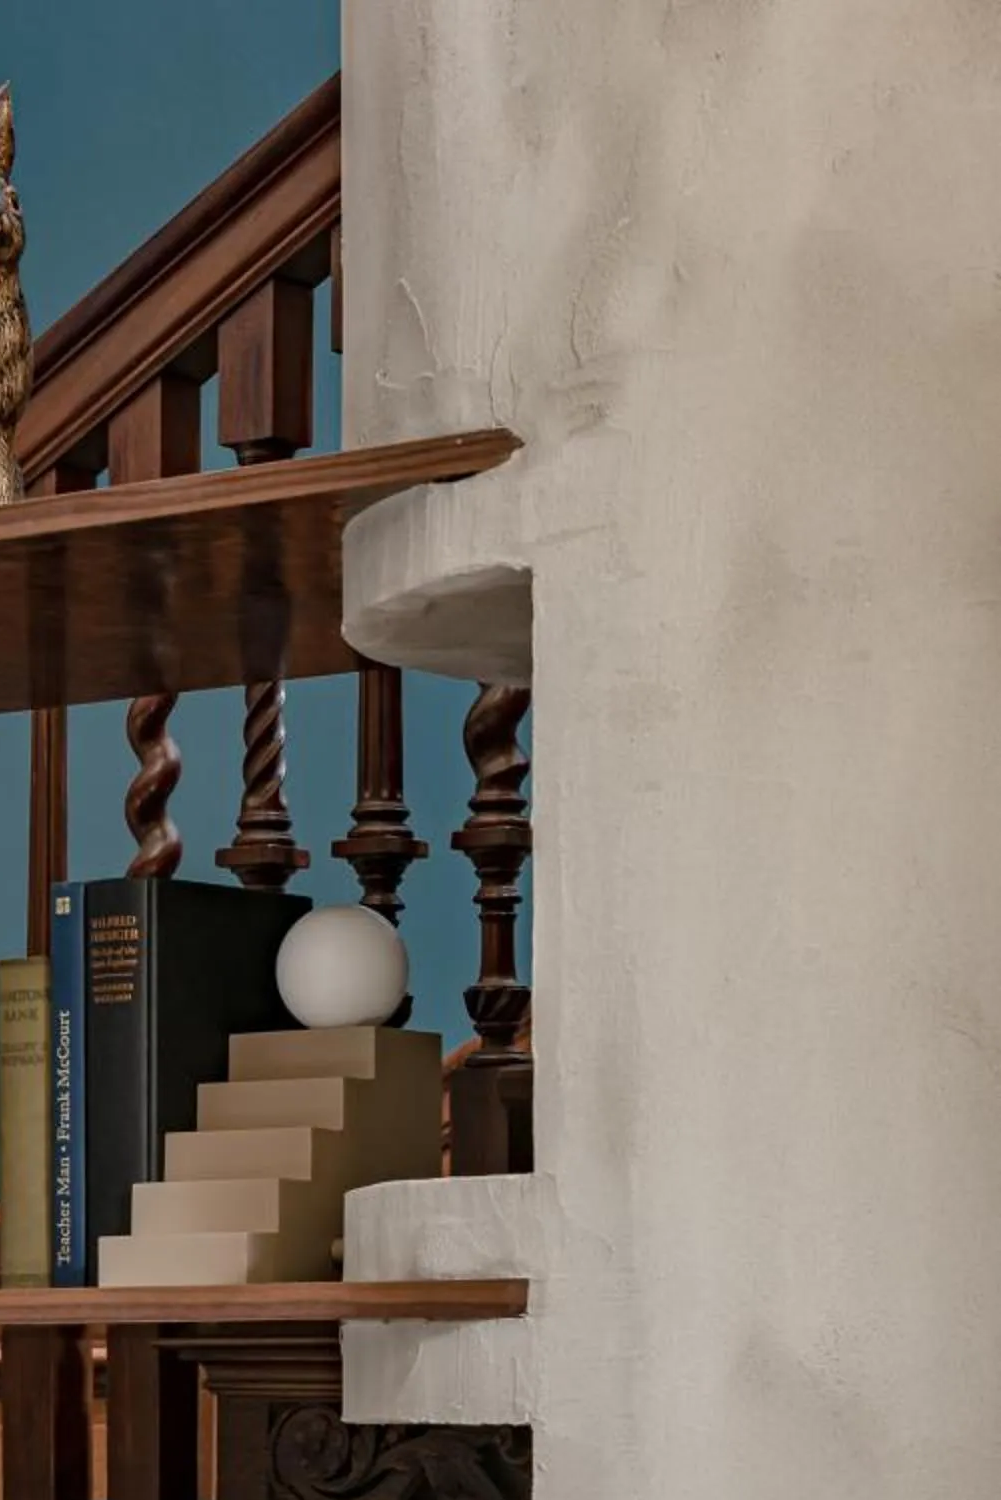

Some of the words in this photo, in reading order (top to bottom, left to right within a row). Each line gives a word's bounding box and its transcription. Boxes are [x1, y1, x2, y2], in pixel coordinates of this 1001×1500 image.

[56, 1009, 72, 1088] McCourt
[56, 1090, 72, 1142] Frank
[56, 1156, 72, 1196] Man
[56, 1199, 72, 1268] Teacher
